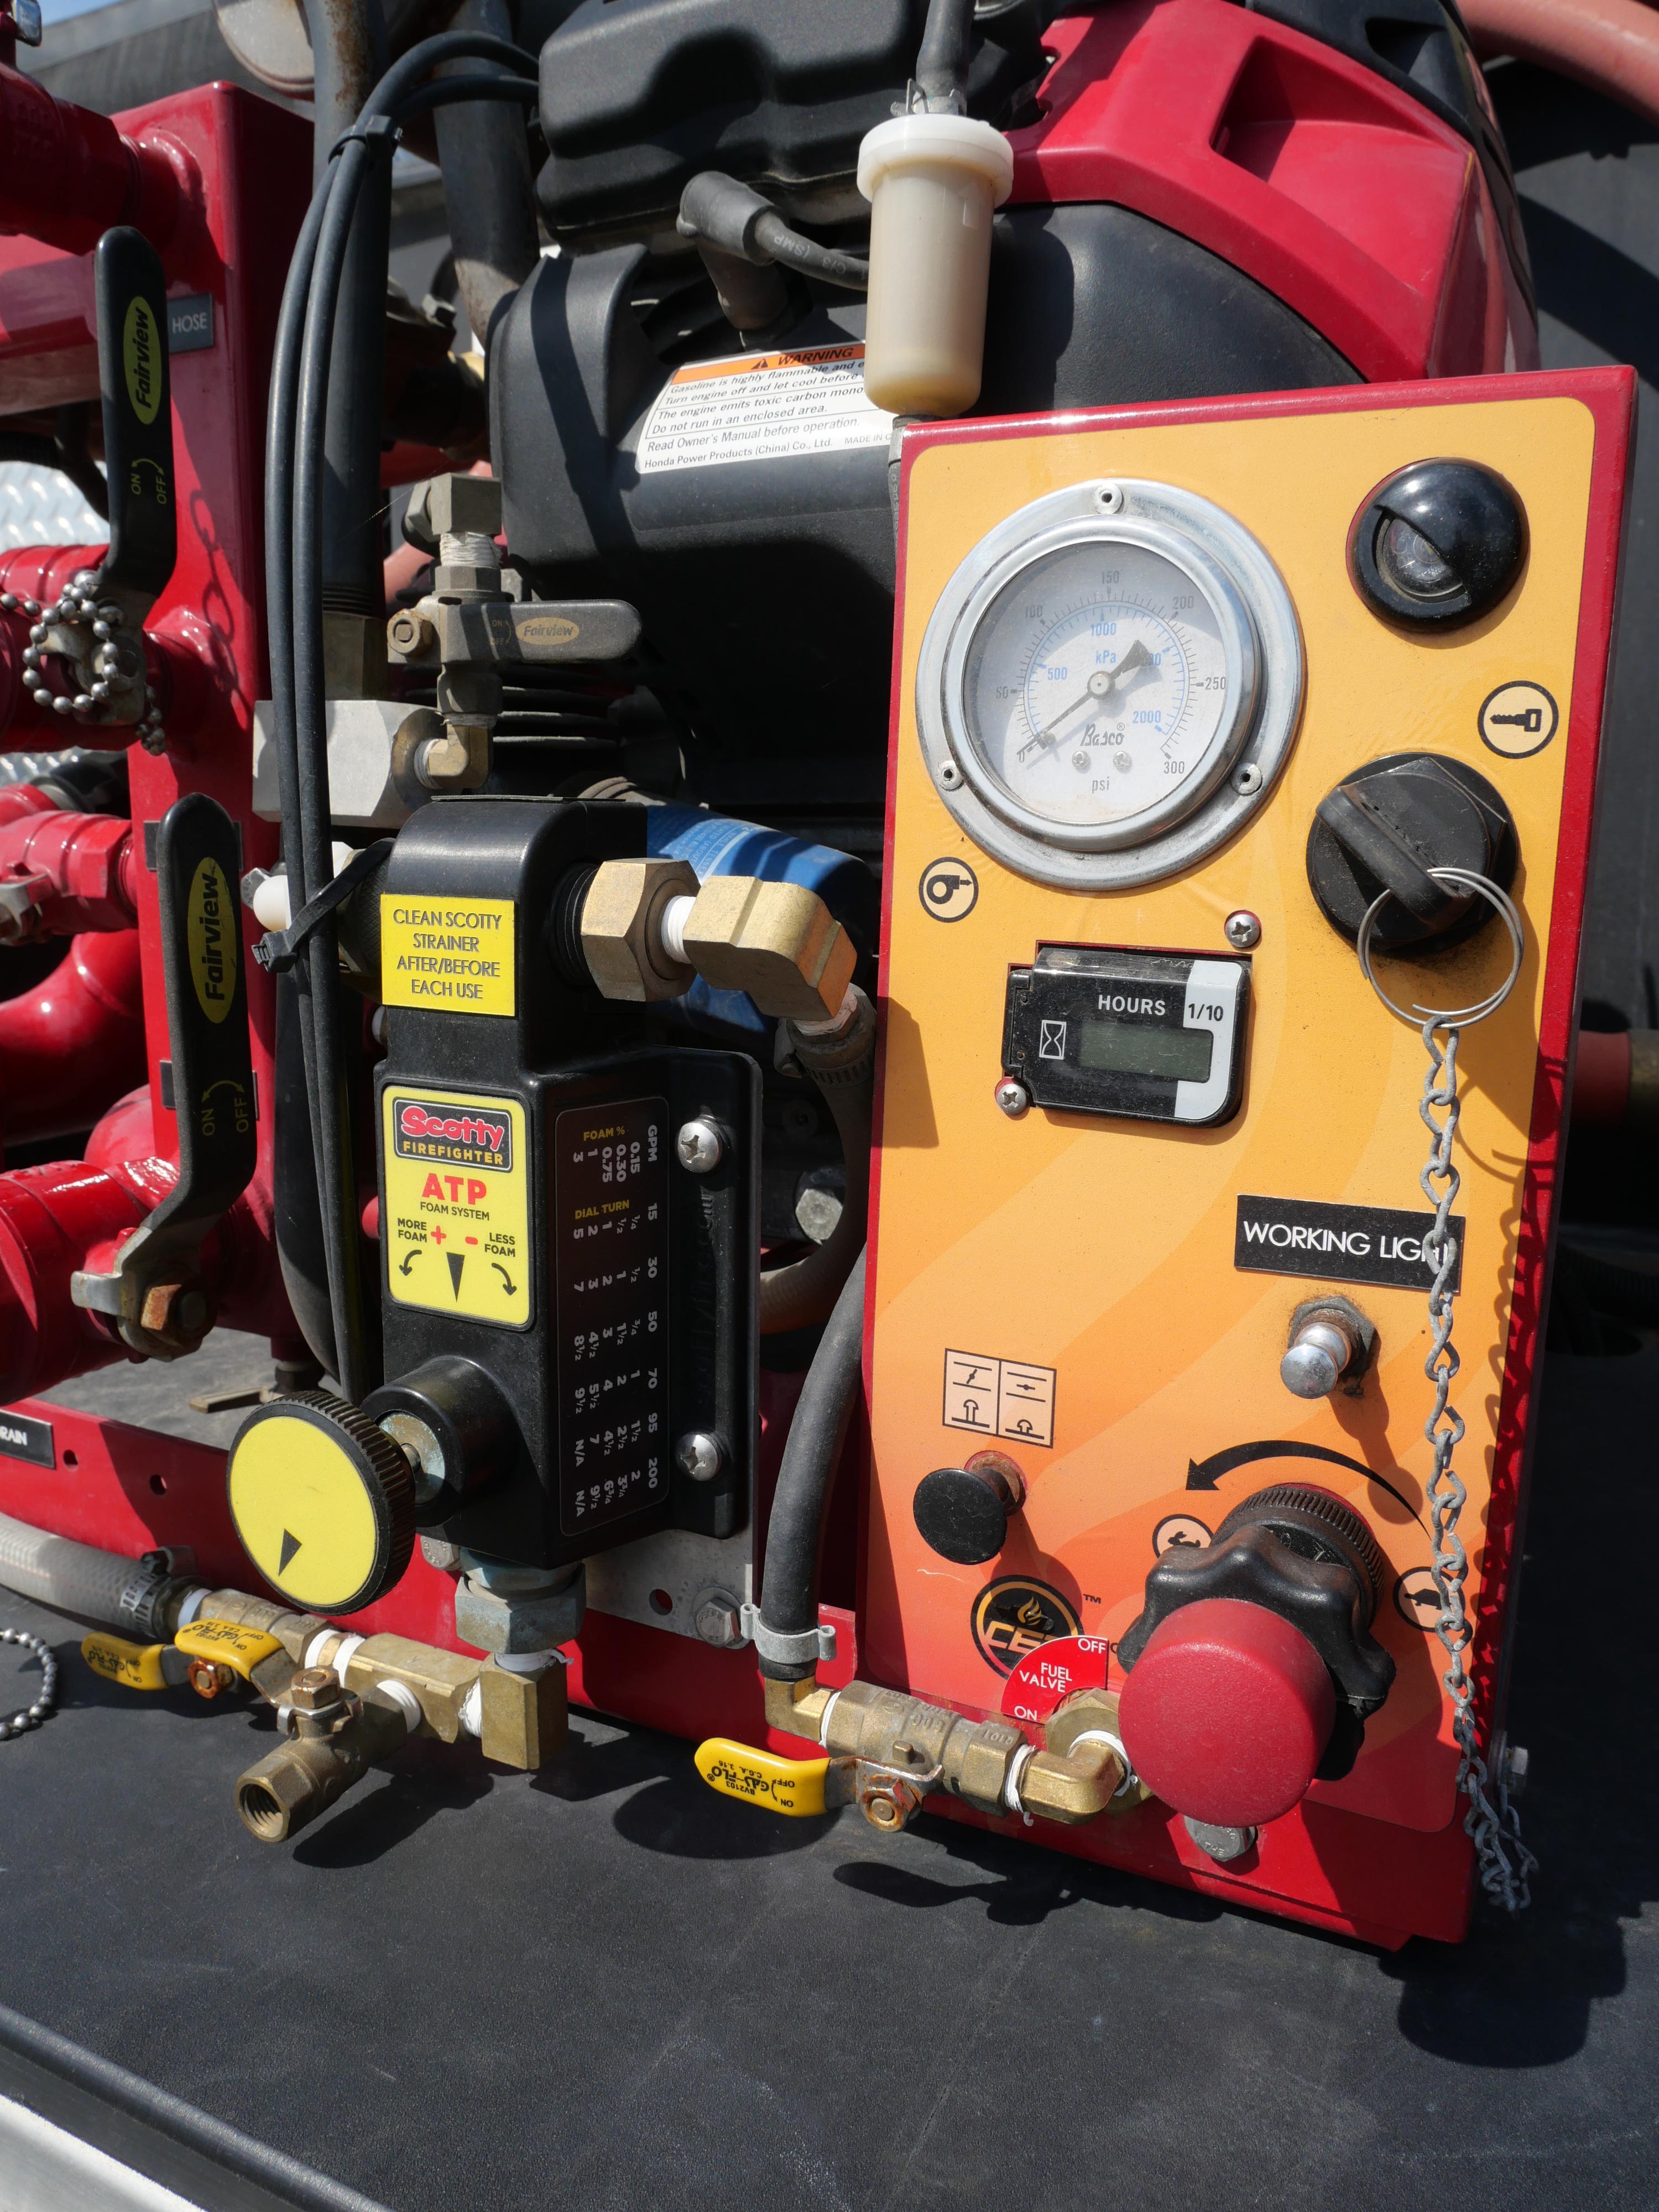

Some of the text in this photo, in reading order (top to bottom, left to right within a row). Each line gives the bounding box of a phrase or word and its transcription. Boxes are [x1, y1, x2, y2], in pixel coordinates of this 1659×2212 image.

[173, 312, 207, 333] HOSE
[134, 306, 152, 409] Fairview
[778, 347, 854, 366] WARNING
[671, 381, 716, 394] Gasoline
[719, 378, 728, 386] is
[731, 372, 765, 385] highly
[768, 366, 828, 379] flammable
[832, 361, 855, 371] and
[665, 397, 687, 405] Turn
[691, 391, 727, 401] engine
[731, 387, 747, 395] off
[749, 383, 771, 393] and
[774, 382, 789, 390] let
[792, 377, 817, 388] cool
[820, 373, 858, 384] before
[658, 387, 864, 420] The engine emits toxic carbon mono
[652, 405, 827, 434] Do not run in an enclosed area.
[648, 418, 860, 452] Read Owner's Manual before operation.
[645, 458, 675, 469] Honda
[677, 455, 707, 465] Power
[709, 449, 753, 460] Products
[755, 442, 790, 456] (China)
[792, 441, 811, 450] Co.,
[814, 438, 833, 448] Ltd.
[844, 435, 871, 445] MADE
[132, 473, 140, 494] ON
[156, 478, 166, 504] OFF
[1101, 571, 1120, 585] 150
[1025, 604, 1044, 618] 100
[1173, 596, 1194, 609] 200
[524, 624, 574, 637] Fairview
[1090, 623, 1117, 637] 1000
[1095, 650, 1117, 664] kPa
[1047, 667, 1068, 680] 500
[1204, 676, 1226, 690] 250
[996, 686, 1009, 699] 50
[1132, 711, 1162, 724] 2000
[1019, 750, 1025, 763] 0
[1163, 761, 1185, 775] 300
[1092, 777, 1110, 794] psi
[393, 909, 502, 930] CLEAN SCOTTY
[202, 873, 225, 1001] Fairview
[413, 933, 479, 952] STRAINER
[397, 955, 500, 977] AFTER/BEFORE
[411, 979, 483, 999] EACH USE
[1098, 994, 1166, 1016] HOURS
[1188, 1003, 1224, 1022] 1/10
[202, 1108, 216, 1136] ON
[234, 1097, 249, 1133] OFF
[401, 1105, 504, 1151] Scotty
[583, 1125, 625, 1141] FOAM %
[403, 1141, 504, 1165] FIREFIGHTER
[573, 1151, 584, 1163] 3
[588, 1148, 598, 1157] 1
[630, 1141, 640, 1175] 0.15
[602, 1146, 613, 1183] 0.75
[616, 1144, 627, 1182] 0.30
[421, 1172, 487, 1205] ATP
[420, 1202, 490, 1221] FOAM SYSTEM
[575, 1199, 630, 1219] DIAL TURN
[397, 1218, 427, 1231] MORE
[588, 1225, 598, 1237] 2
[602, 1221, 613, 1229] 1
[398, 1230, 427, 1243] FOAM
[489, 1232, 515, 1245] LESS
[573, 1228, 584, 1239] 5
[1243, 1220, 1371, 1255] WORKING
[484, 1244, 515, 1258] FOAM
[602, 1275, 613, 1286] 2
[617, 1271, 627, 1279] 1
[573, 1281, 585, 1292] 7
[588, 1278, 598, 1290] 3
[648, 1124, 658, 1489] GPM 15 30 50 70 95 200
[602, 1327, 613, 1338] 3
[617, 1375, 627, 1386] 2
[630, 1370, 641, 1379] 1
[603, 1379, 613, 1391] 4
[0, 1425, 28, 1446] RAIN
[589, 1433, 600, 1445] 7
[575, 1438, 586, 1468] N/A
[631, 1470, 641, 1481] 2
[575, 1490, 586, 1518] N/A
[985, 1621, 1060, 1656] CE
[1078, 1638, 1106, 1654] OFF
[1041, 1662, 1072, 1681] FUEL
[1019, 1670, 1066, 1693] VALVE
[1014, 1705, 1037, 1721] ON
[718, 1760, 763, 1779] C.G.A. 3.16
[726, 1780, 755, 1796] BV2103
[777, 1778, 795, 1788] OFF
[780, 1798, 794, 1808] ON
